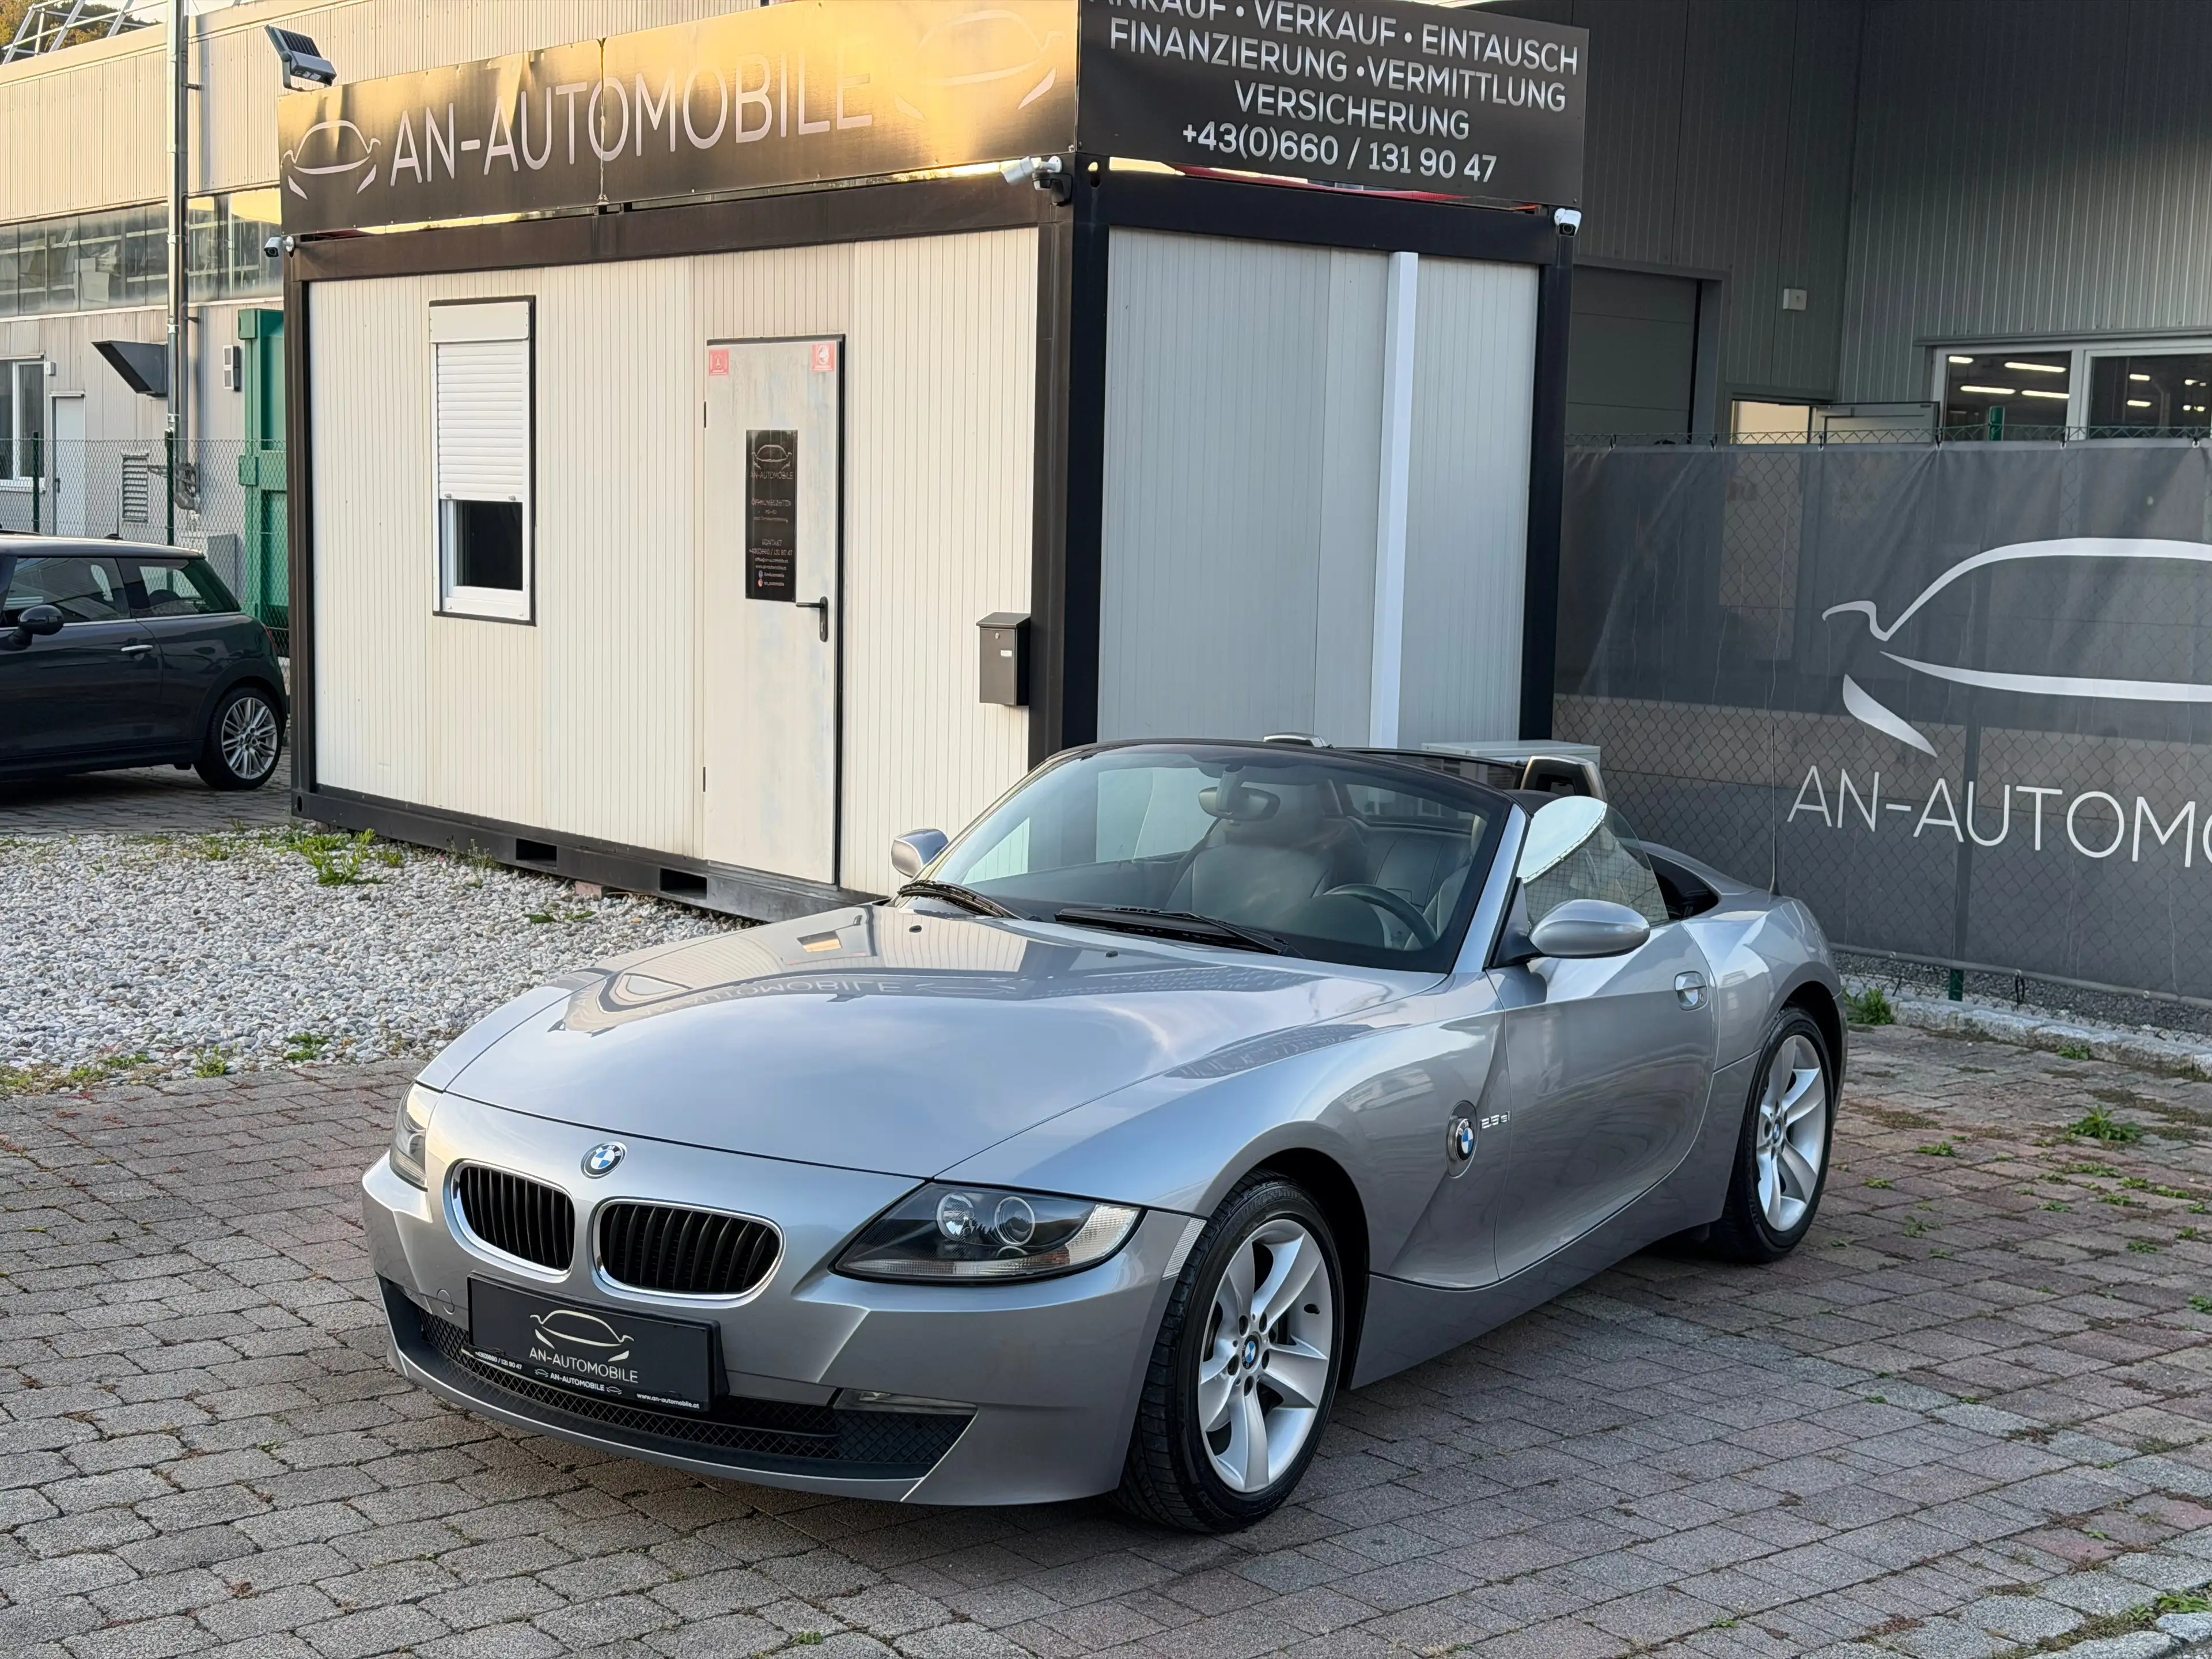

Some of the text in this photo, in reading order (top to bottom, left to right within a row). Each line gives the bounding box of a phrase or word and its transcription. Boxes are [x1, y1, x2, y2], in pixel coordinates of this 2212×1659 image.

[1111, 17, 1566, 112] FINANZIERUNG VERMITTLUNG
[1254, 0, 1396, 47] VERKAUF
[1422, 23, 1578, 75] EINTAUSCH
[390, 40, 873, 187] AN-AUTOMOBILE
[1234, 79, 1470, 140] VERSICHERUNG
[1183, 120, 1498, 183] +43(0)660 / 131 90 47
[1787, 765, 2212, 868] AN-AUTOM
[528, 1347, 638, 1384] AN-AUTOMOBILE
[550, 1372, 605, 1392] AN-AUTOMOBILE
[637, 1393, 700, 1409] www.an-automobile.at
